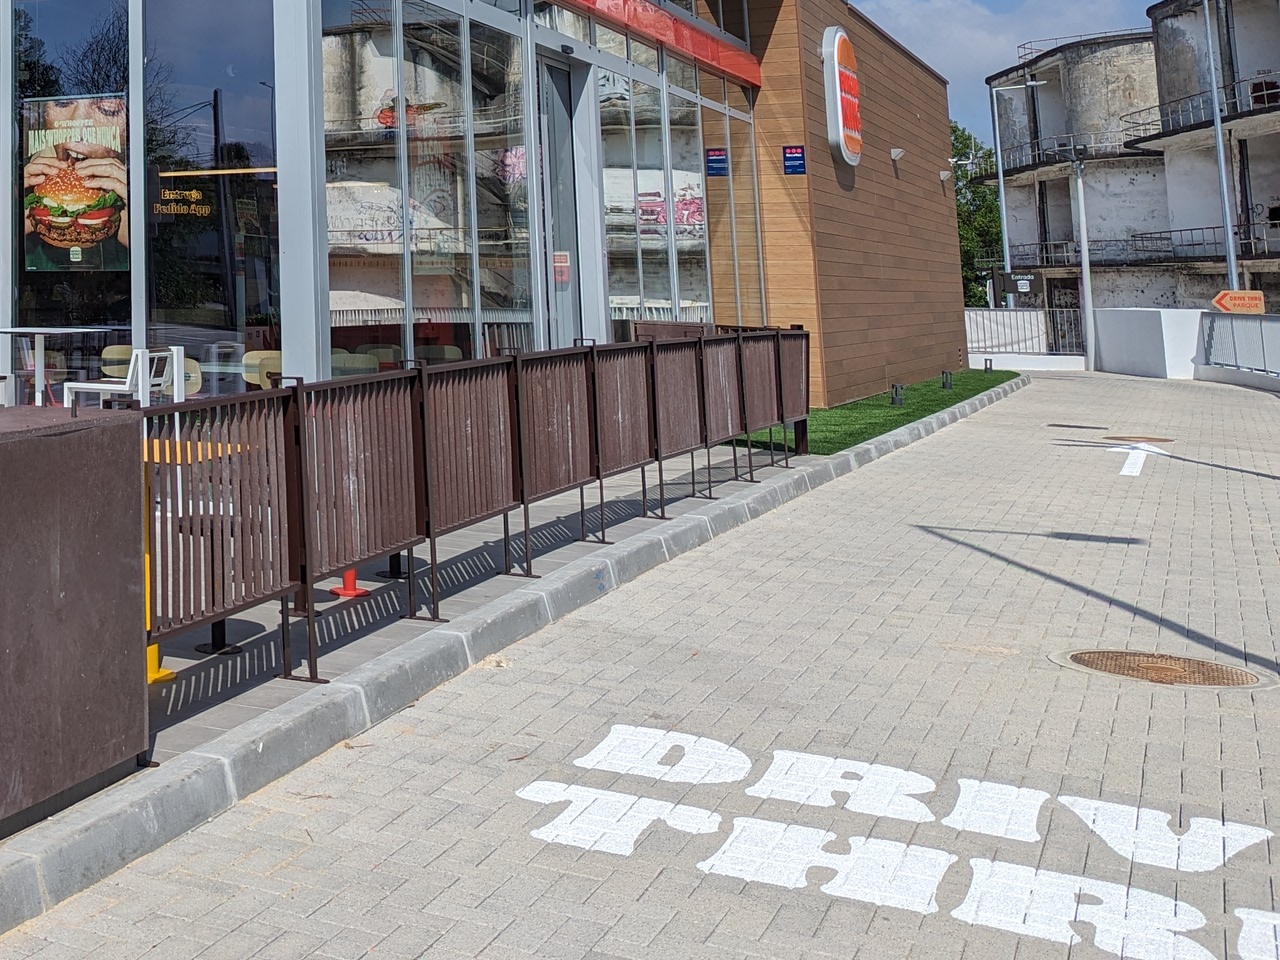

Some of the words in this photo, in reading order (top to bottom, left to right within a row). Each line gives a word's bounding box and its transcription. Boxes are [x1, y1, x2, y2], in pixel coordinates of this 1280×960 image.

[28, 129, 46, 157] MAIS
[45, 127, 81, 149] WHOPPER
[82, 126, 97, 146] QUE
[96, 125, 122, 154] NUNCA
[153, 203, 188, 214] Pedido
[189, 204, 211, 216] App
[514, 779, 1280, 960] THR
